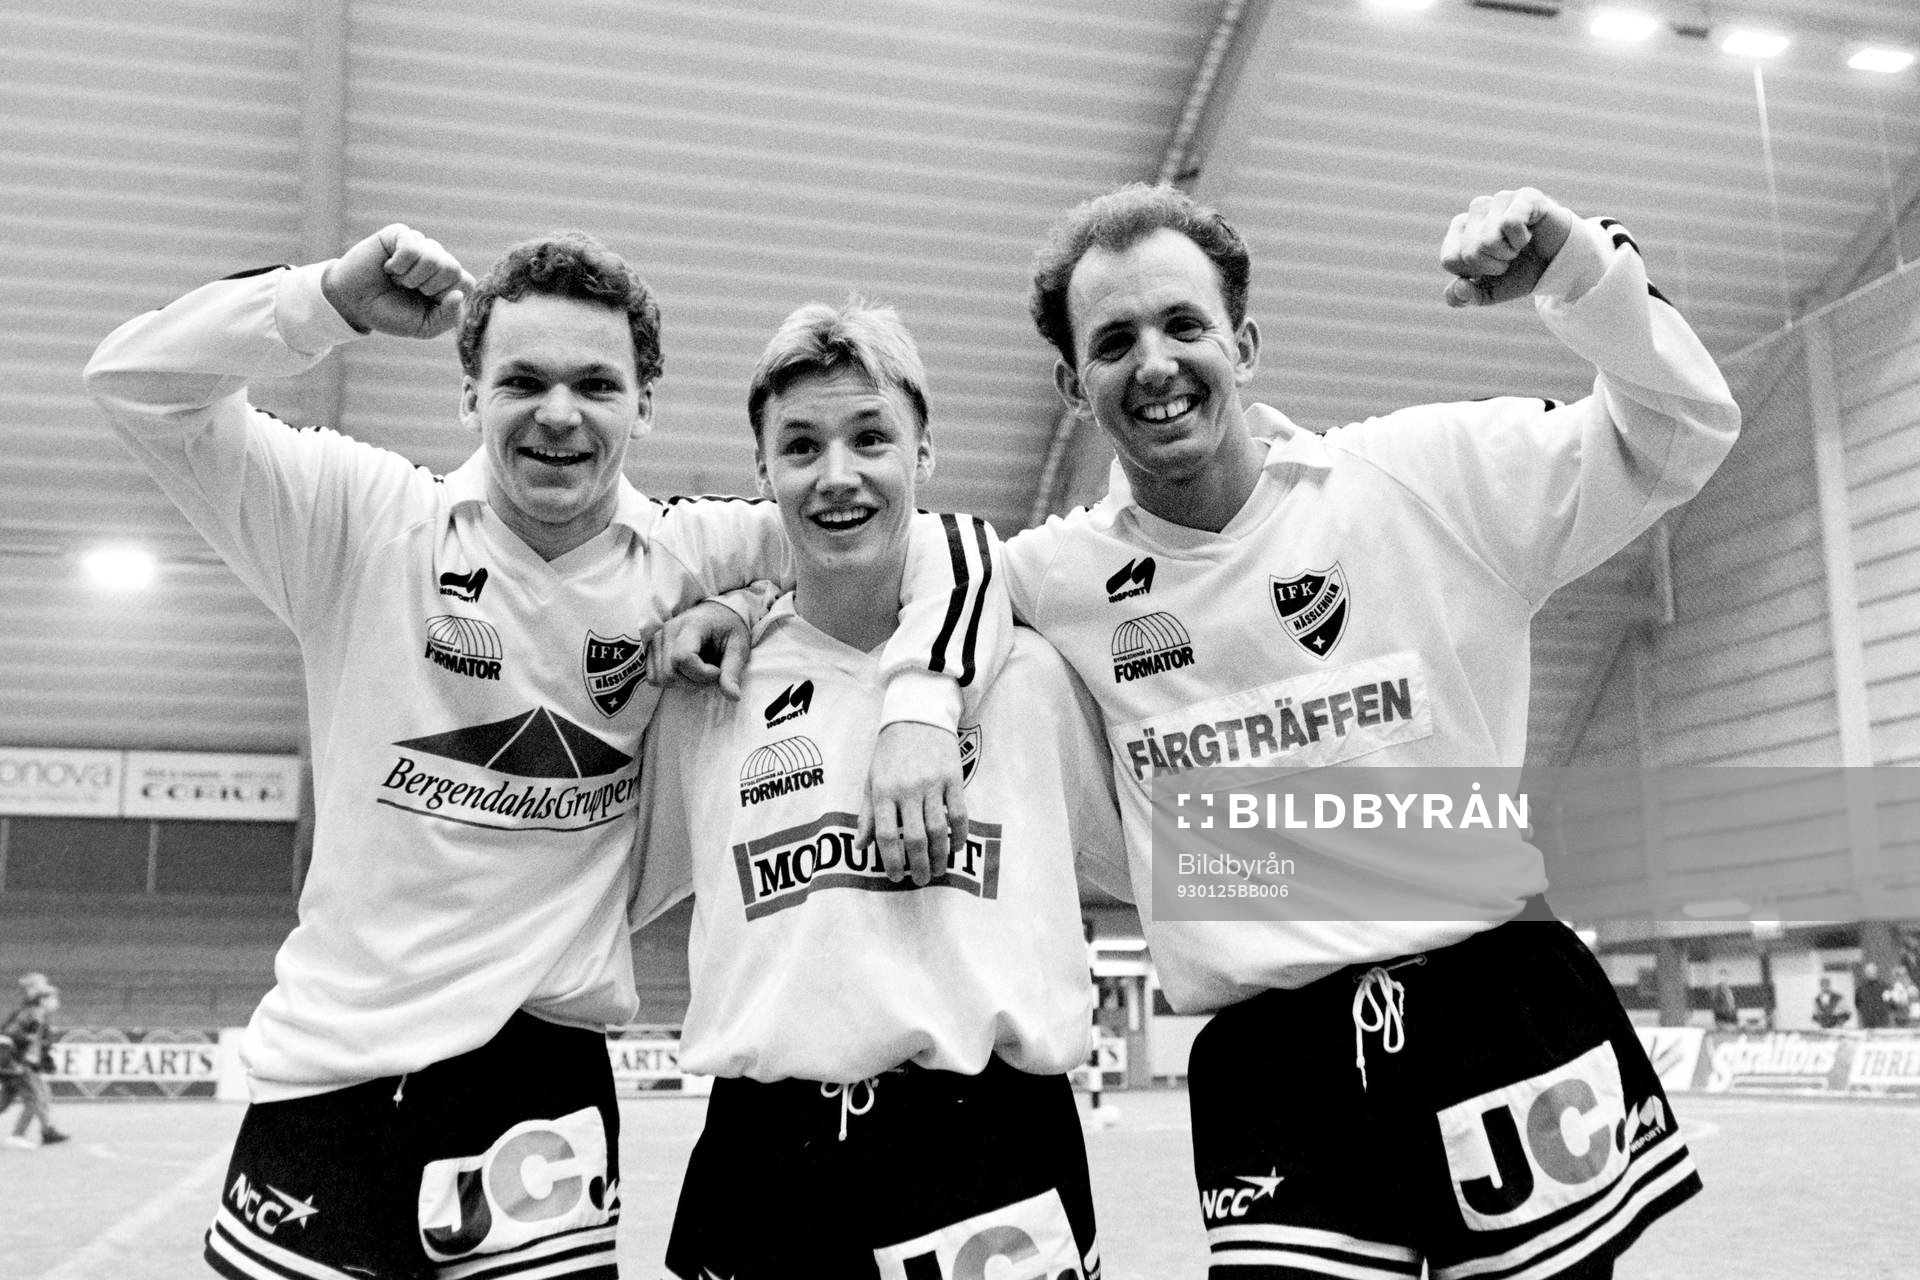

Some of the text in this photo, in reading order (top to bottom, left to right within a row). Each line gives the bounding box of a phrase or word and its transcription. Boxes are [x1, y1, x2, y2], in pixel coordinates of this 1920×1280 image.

[1108, 587, 1146, 604] INSPORT
[1276, 581, 1316, 602] IFK
[1292, 583, 1340, 631] HÄSSLEHOLM
[425, 640, 503, 681] FORMATOR
[591, 645, 626, 660] IFK
[1113, 646, 1196, 684] FORMATOR
[766, 708, 804, 730] INSPORT
[1126, 677, 1413, 782] FÄRGTRÄFFEN
[740, 767, 825, 808] FORMATOR
[95, 1049, 213, 1075] HEARTS
[229, 1172, 284, 1235] NCC
[1202, 1187, 1256, 1220] NCC
